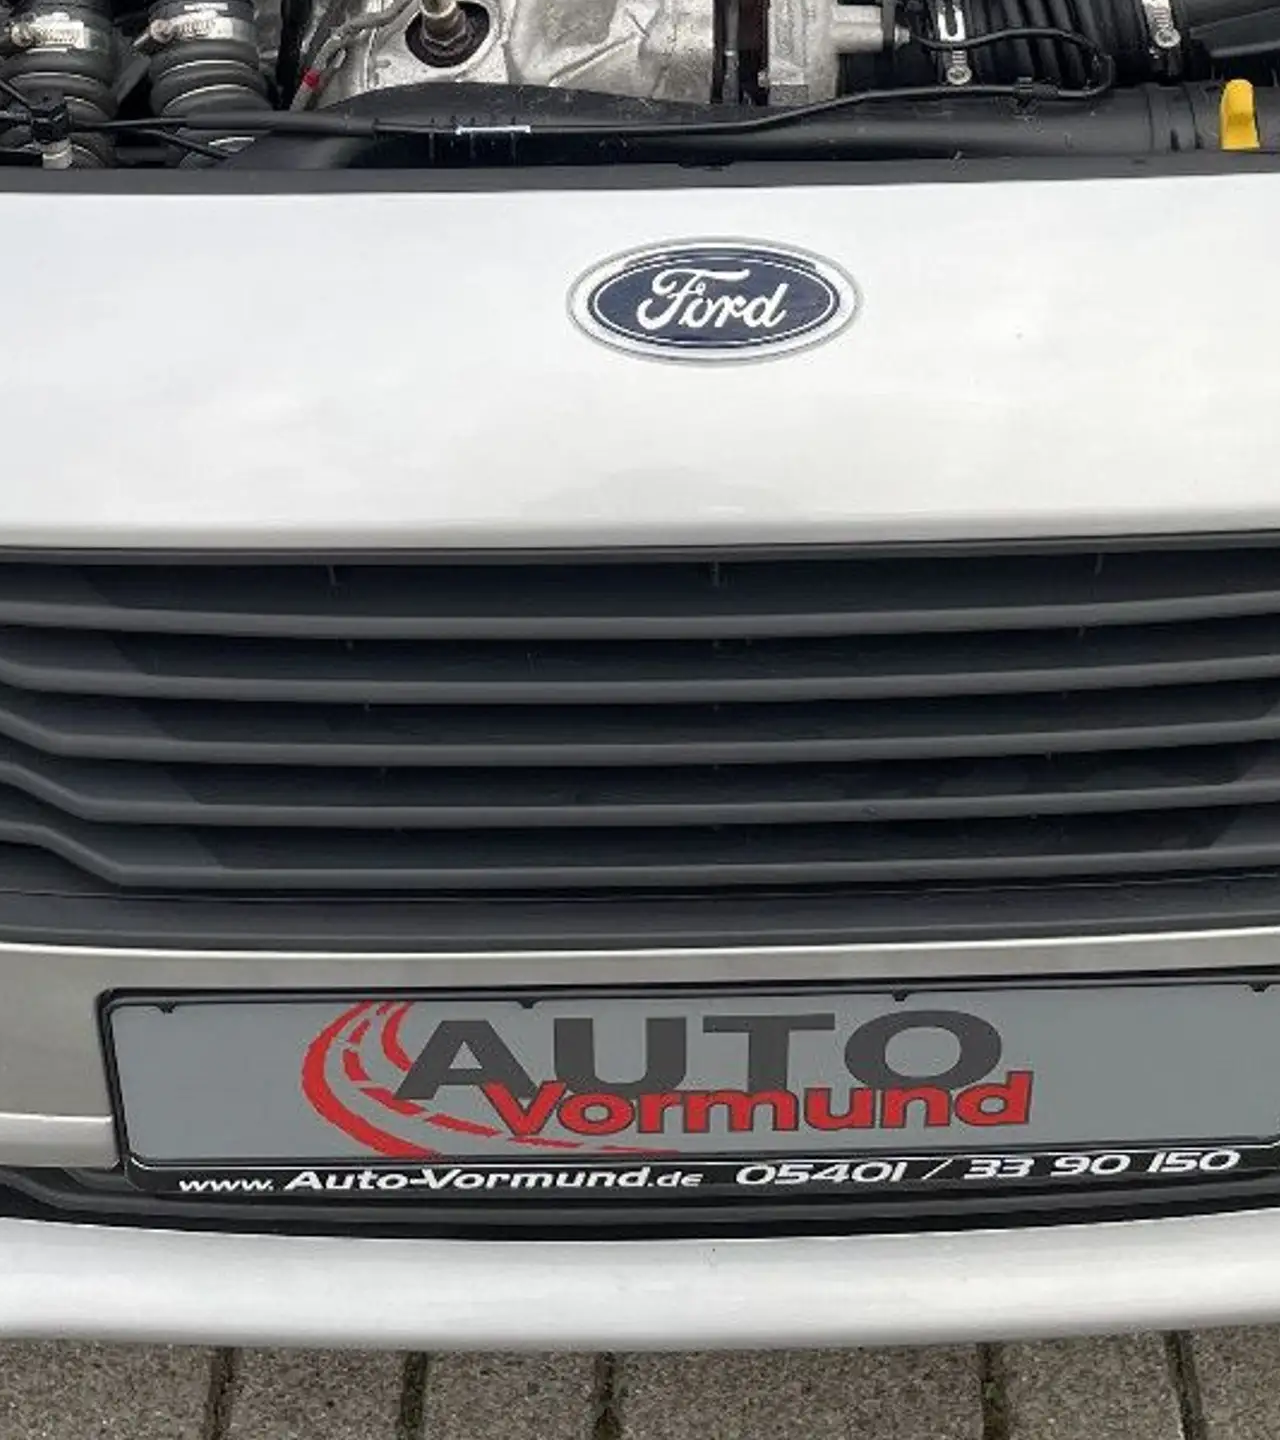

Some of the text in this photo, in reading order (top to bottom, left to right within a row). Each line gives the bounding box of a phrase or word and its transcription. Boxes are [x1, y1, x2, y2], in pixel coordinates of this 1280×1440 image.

[635, 267, 789, 331] Ford
[393, 1008, 1004, 1100] AUTO
[480, 1070, 1035, 1138] Vormund
[735, 1161, 908, 1186] 05401
[963, 1157, 1031, 1180] 33
[1049, 1153, 1131, 1177] 90
[1146, 1149, 1240, 1174] 150
